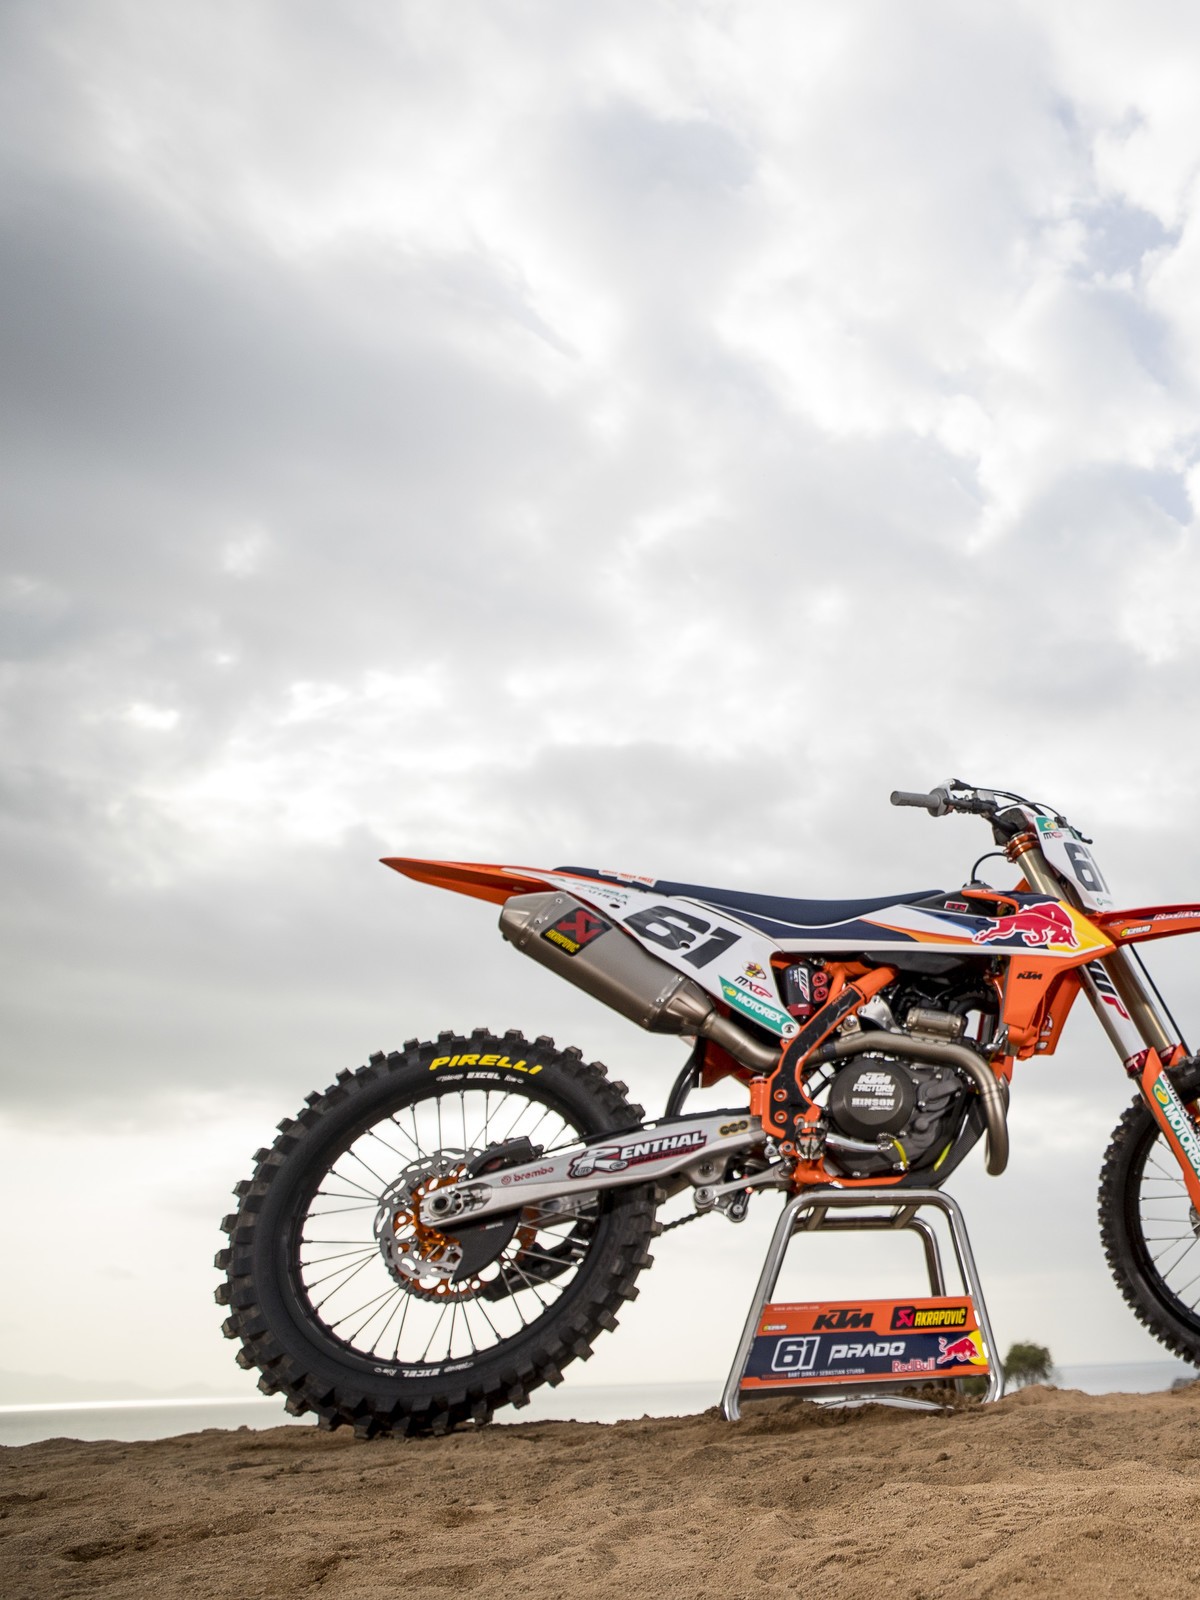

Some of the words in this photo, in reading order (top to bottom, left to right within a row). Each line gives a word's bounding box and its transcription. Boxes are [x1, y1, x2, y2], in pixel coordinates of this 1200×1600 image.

[622, 905, 742, 970] 61
[1016, 970, 1043, 980] KTM
[734, 992, 786, 1024] MOTOREX
[428, 1054, 543, 1075] PIRELLI
[466, 1071, 501, 1080] EXCEL
[858, 1072, 892, 1084] KTM
[853, 1083, 896, 1093] FACTORY
[513, 1167, 554, 1182] brembo
[812, 1308, 874, 1330] KTM
[771, 1336, 821, 1372] 61
[827, 1342, 906, 1367] PRADO
[892, 1360, 913, 1373] Red
[914, 1357, 936, 1371] Bull
